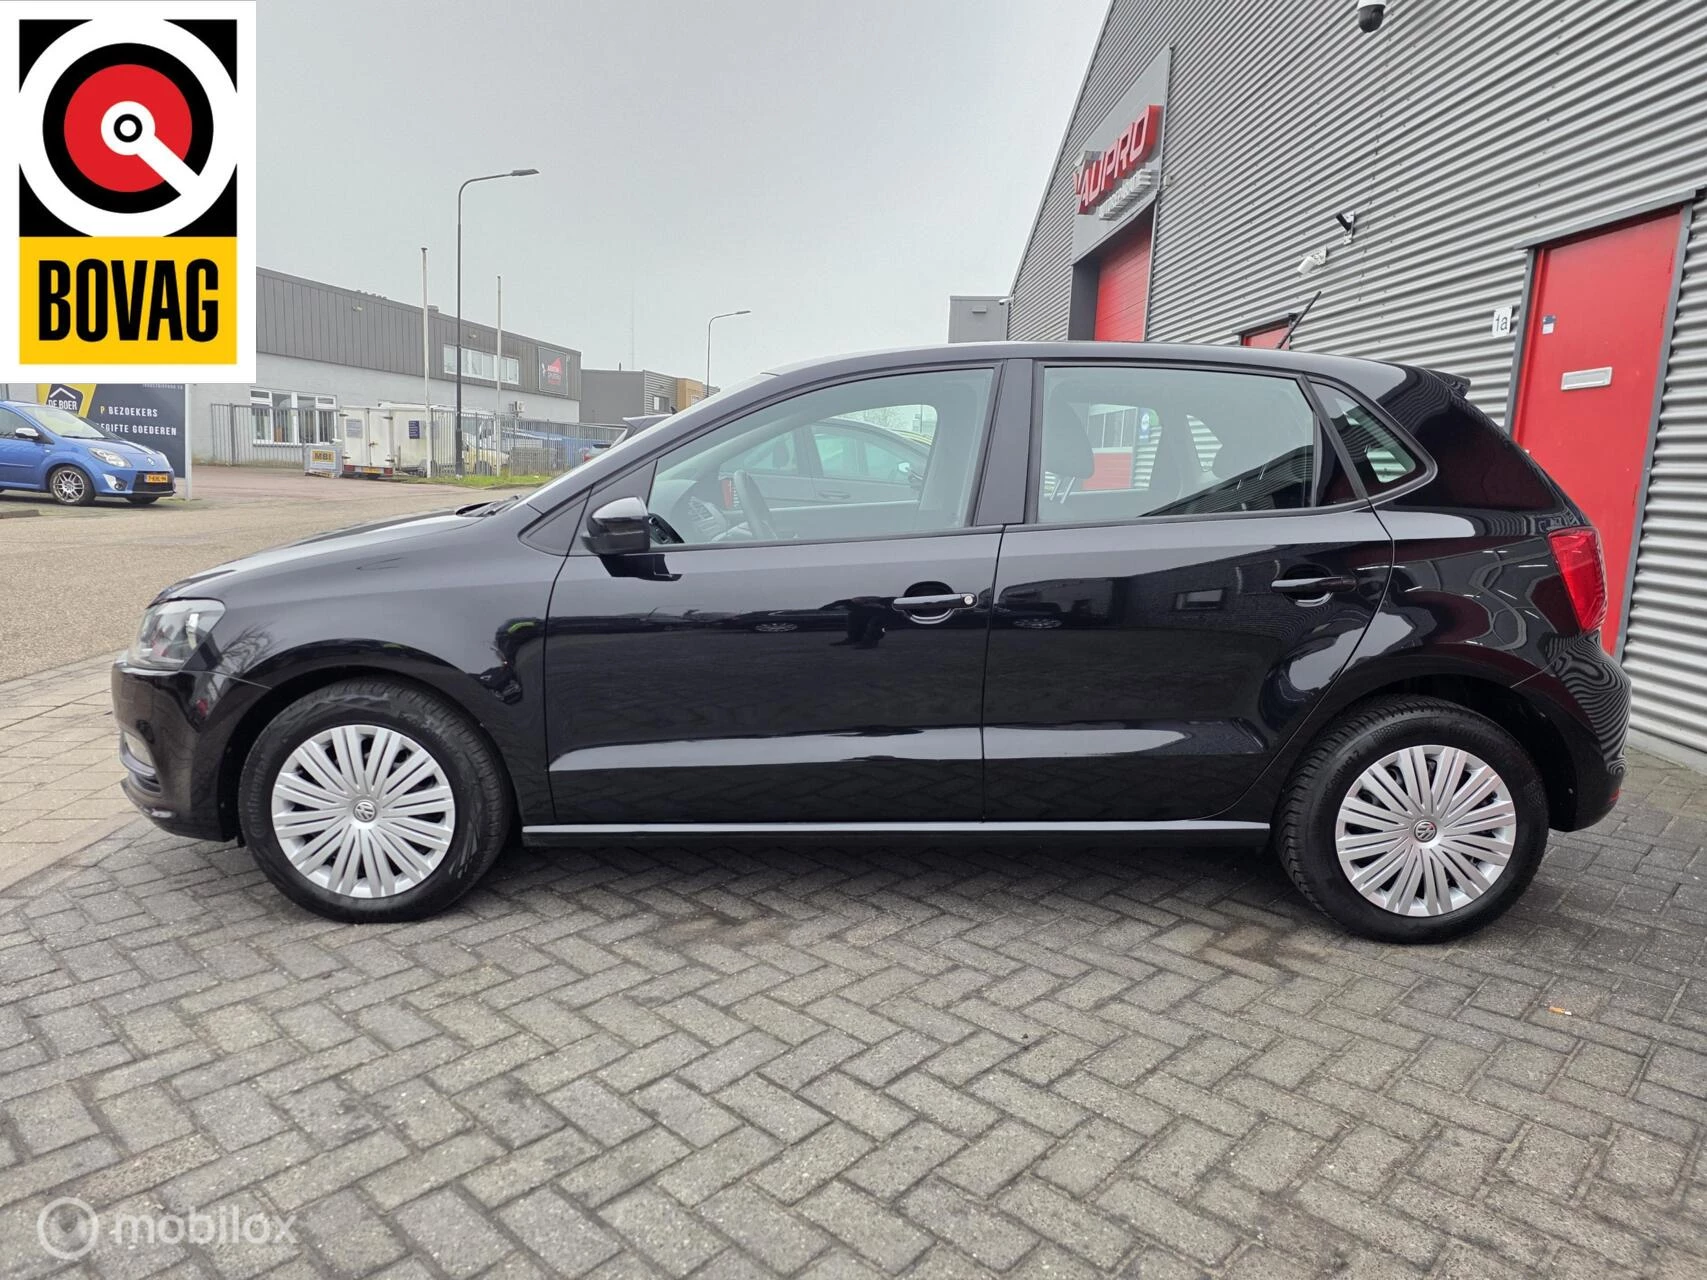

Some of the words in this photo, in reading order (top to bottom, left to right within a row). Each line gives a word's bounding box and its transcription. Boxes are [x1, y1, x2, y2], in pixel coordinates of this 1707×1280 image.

[1495, 315, 1508, 332] 1a
[58, 400, 78, 411] BOER
[108, 406, 158, 418] BEZOEKERS
[132, 424, 177, 436] GOEDEREN
